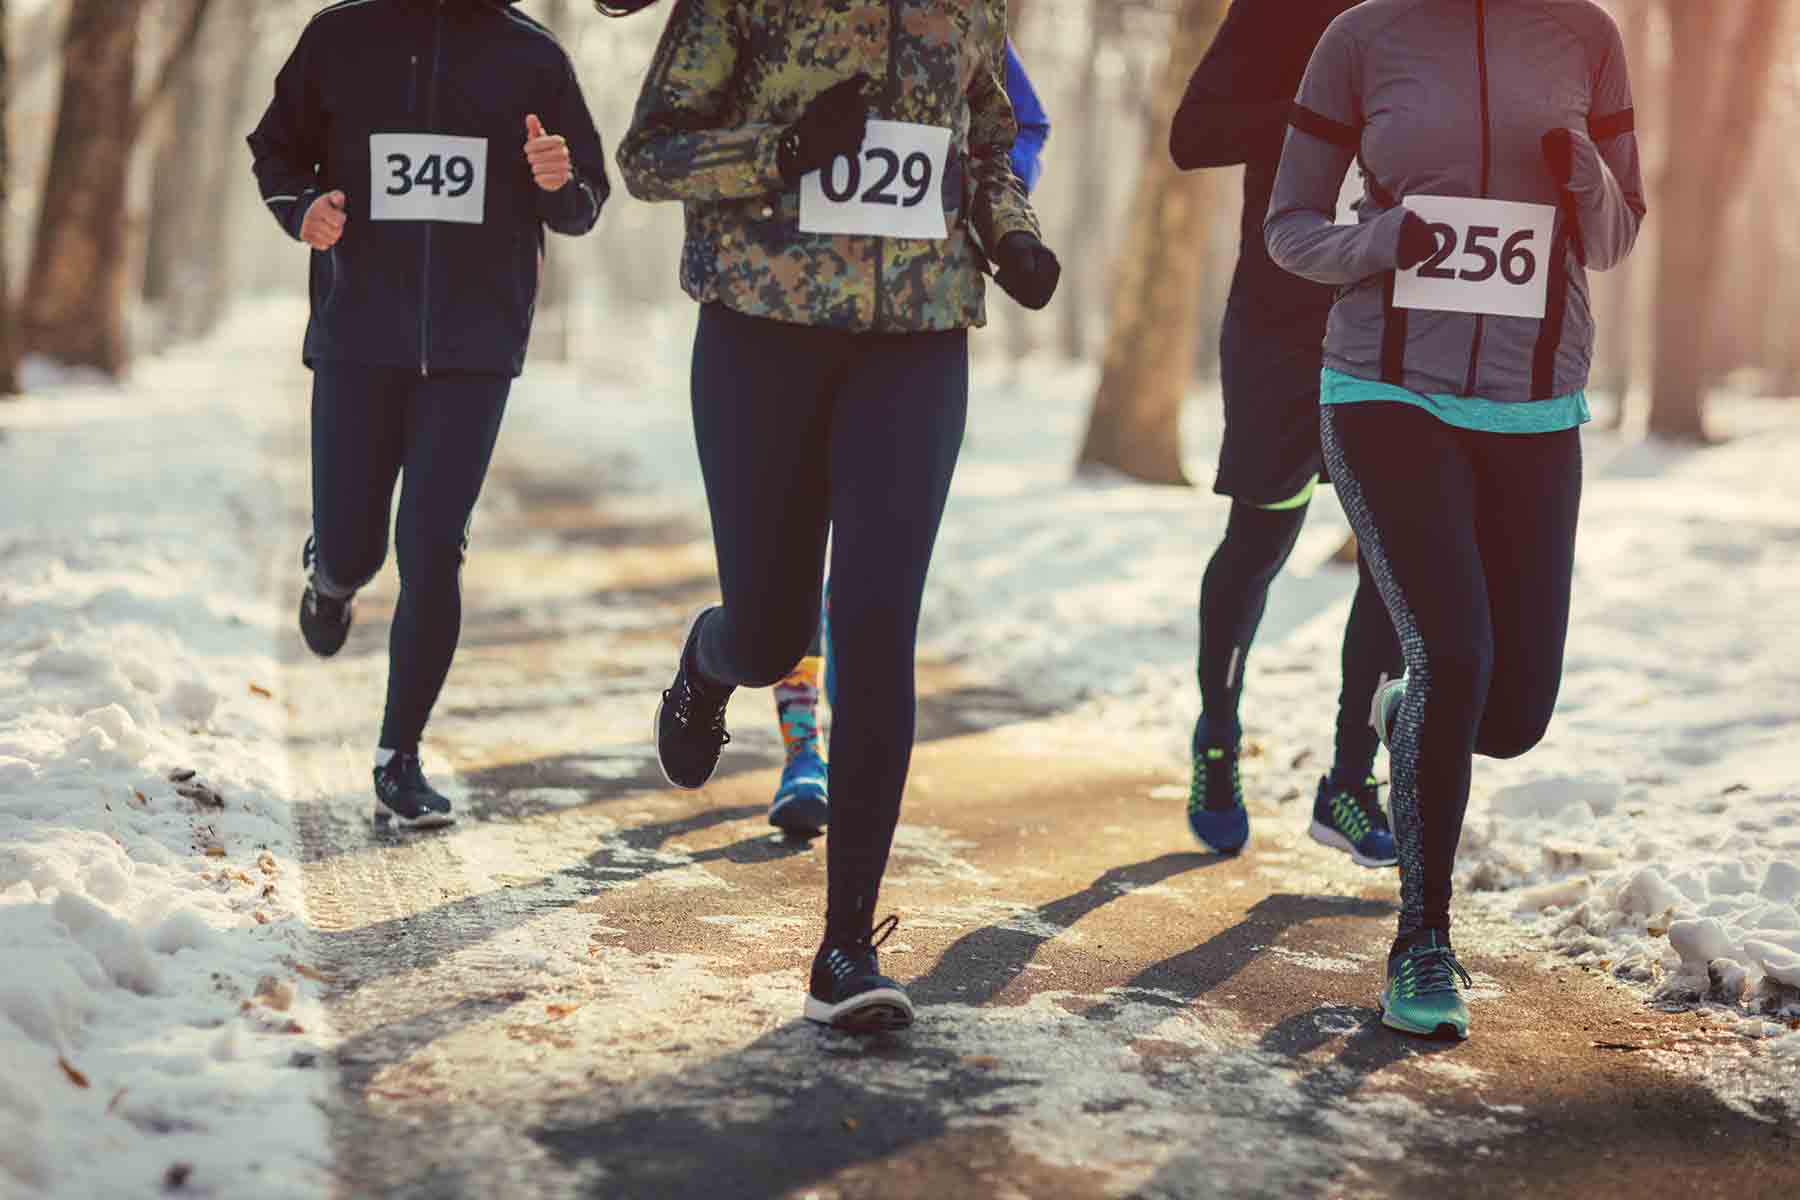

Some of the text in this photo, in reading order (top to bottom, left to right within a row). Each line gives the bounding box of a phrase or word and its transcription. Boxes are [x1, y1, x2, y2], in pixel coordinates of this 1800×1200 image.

[385, 153, 474, 197] 349
[820, 147, 932, 207] 029
[1416, 222, 1536, 285] 256
